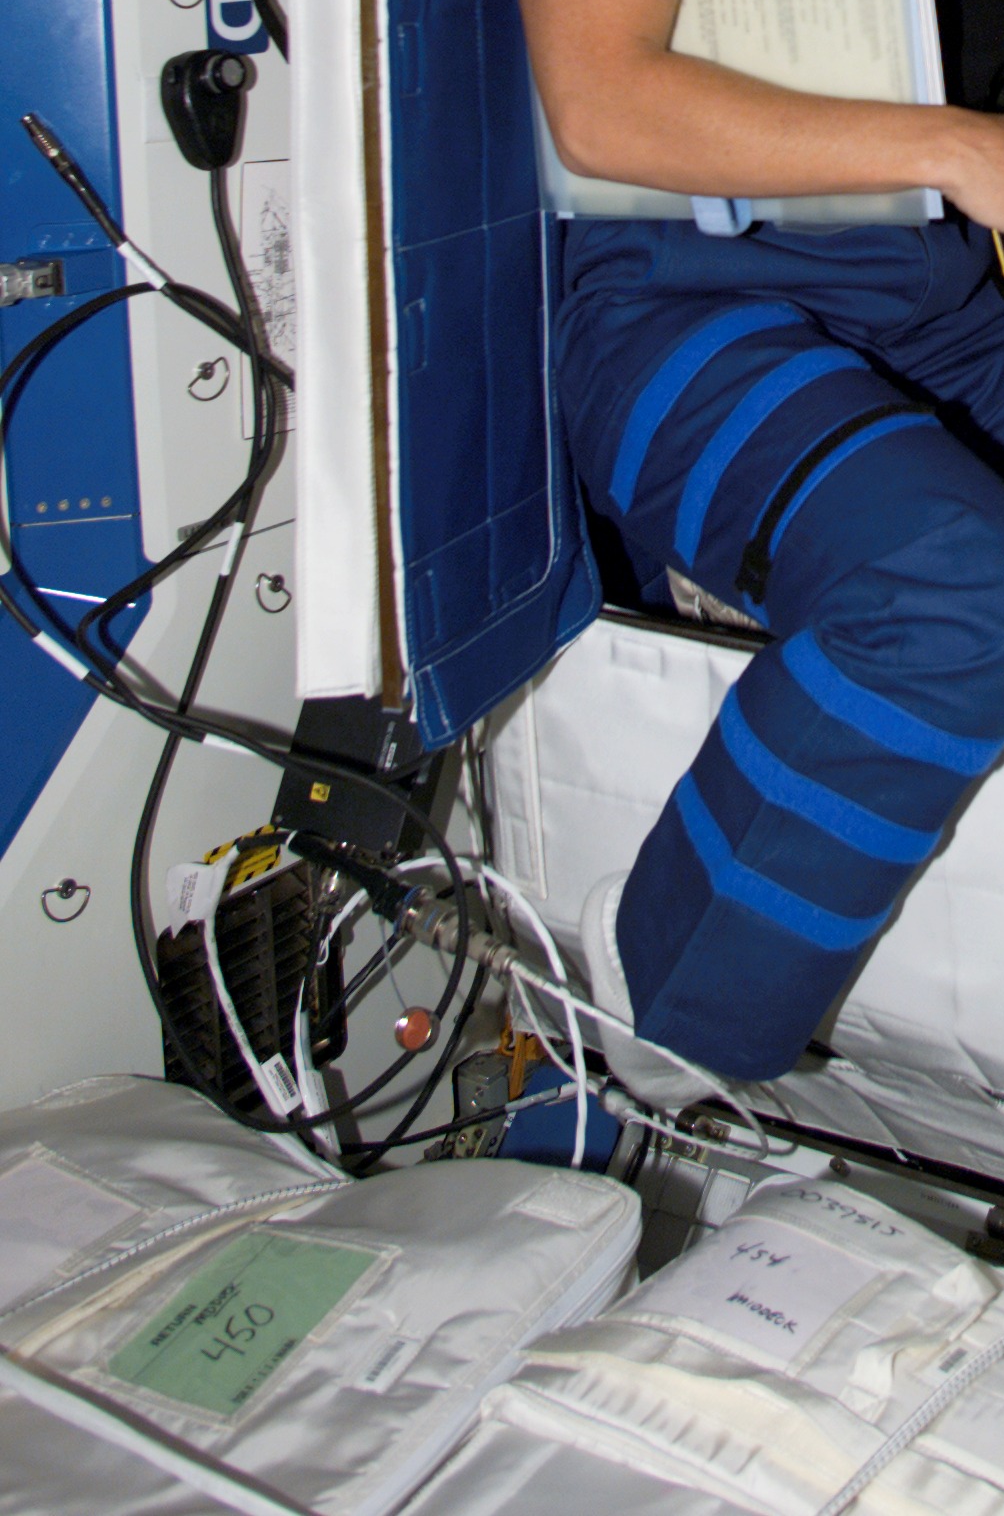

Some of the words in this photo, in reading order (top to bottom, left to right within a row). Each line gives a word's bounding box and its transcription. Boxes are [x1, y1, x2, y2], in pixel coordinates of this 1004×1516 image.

[730, 1242, 791, 1267] 454
[151, 1303, 197, 1347] RETURN
[201, 1302, 275, 1362] 450
